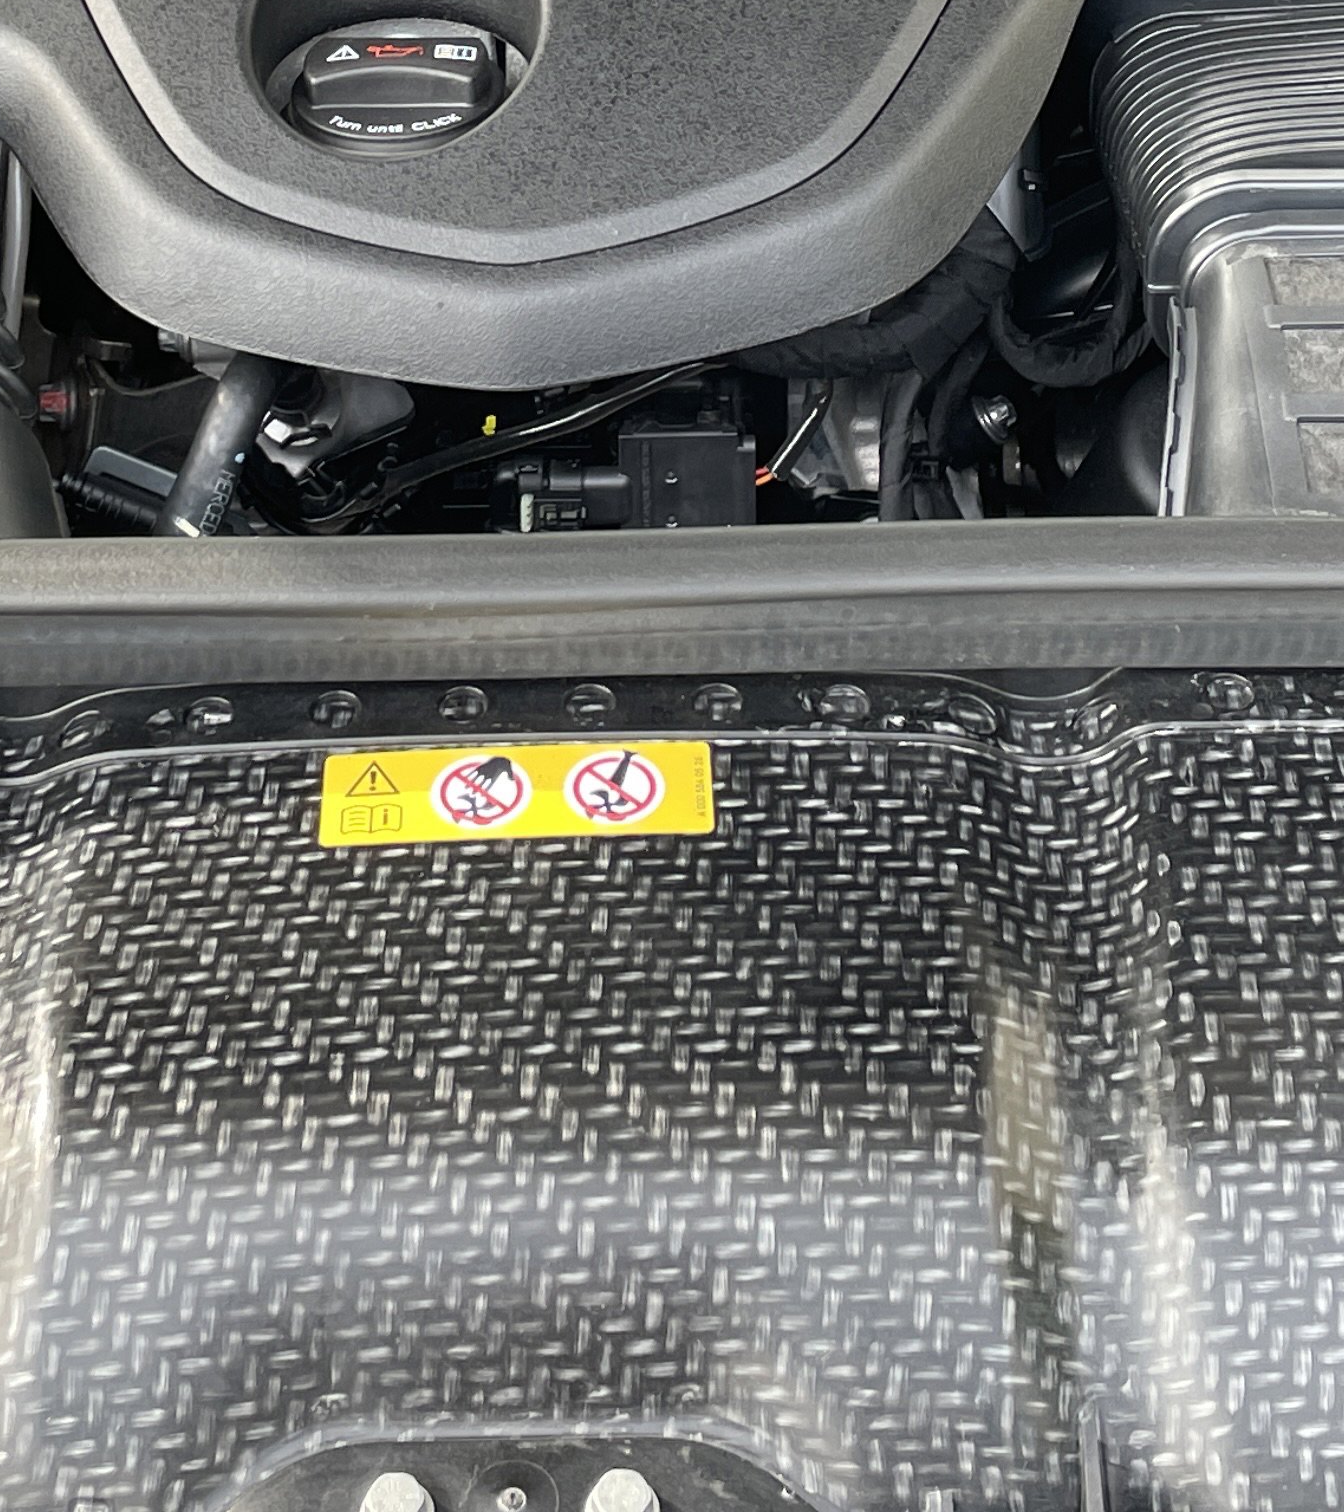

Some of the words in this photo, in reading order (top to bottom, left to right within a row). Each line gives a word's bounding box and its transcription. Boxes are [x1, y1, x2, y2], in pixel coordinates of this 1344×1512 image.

[329, 115, 362, 132] Turn
[367, 123, 404, 134] until
[411, 113, 463, 132] CLICK
